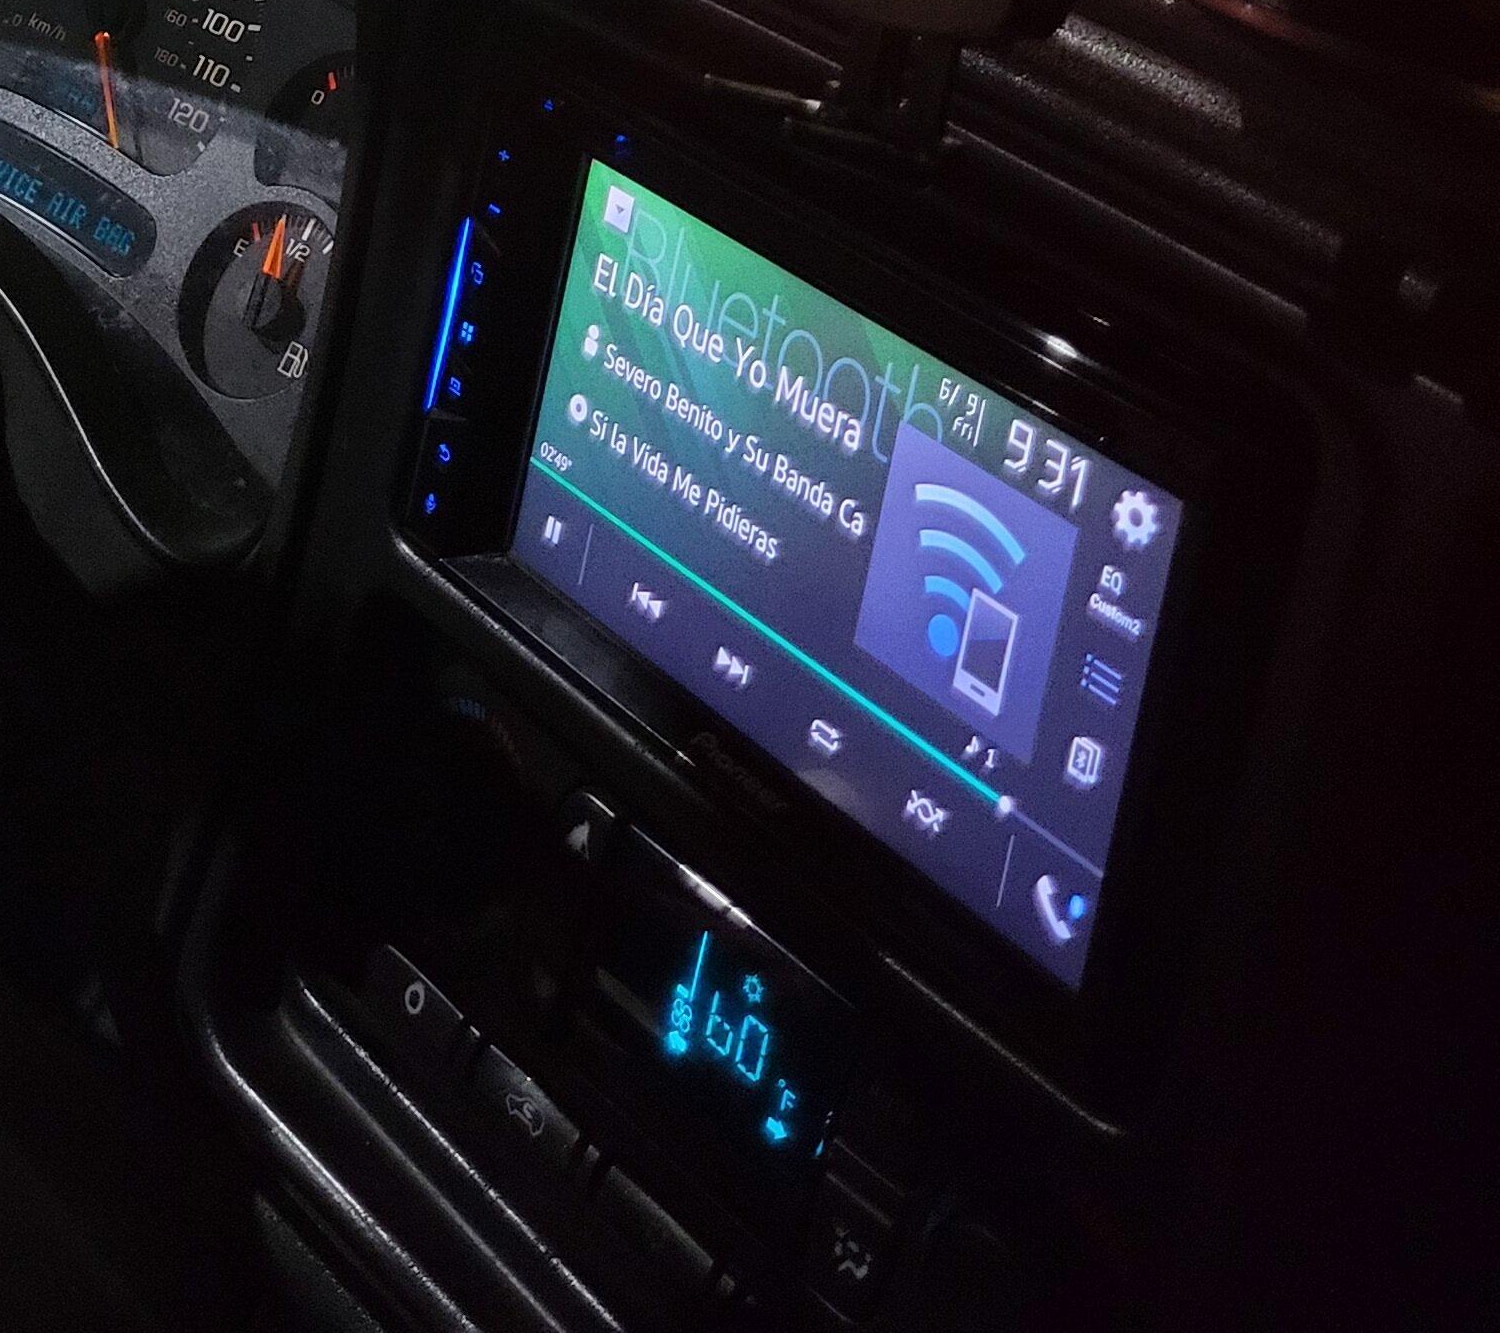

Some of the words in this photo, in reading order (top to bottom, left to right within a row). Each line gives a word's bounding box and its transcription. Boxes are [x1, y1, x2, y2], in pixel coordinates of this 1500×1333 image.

[28, 14, 67, 41] km/h
[202, 8, 245, 43] 100
[193, 55, 231, 87] 110
[168, 98, 210, 133] 120
[46, 191, 88, 230] AIR
[234, 238, 248, 258] E
[286, 238, 311, 262] 1/2
[593, 253, 619, 297] El
[624, 272, 664, 326] Día
[673, 304, 724, 363] Que
[736, 337, 767, 389] Yo
[774, 365, 861, 451] Muera
[603, 343, 662, 400] Severo
[665, 383, 723, 441] Benito
[724, 429, 741, 454] y
[743, 435, 770, 472] Su
[773, 454, 834, 516] Banda
[838, 499, 865, 536] Ca
[589, 410, 609, 441] Si
[610, 423, 627, 455] la
[633, 436, 669, 484] Vida
[672, 466, 701, 506] Me
[704, 488, 778, 559] Pidieras
[1100, 565, 1123, 595] EQ
[1089, 593, 1141, 635] Custom2
[706, 990, 768, 1081] 60
